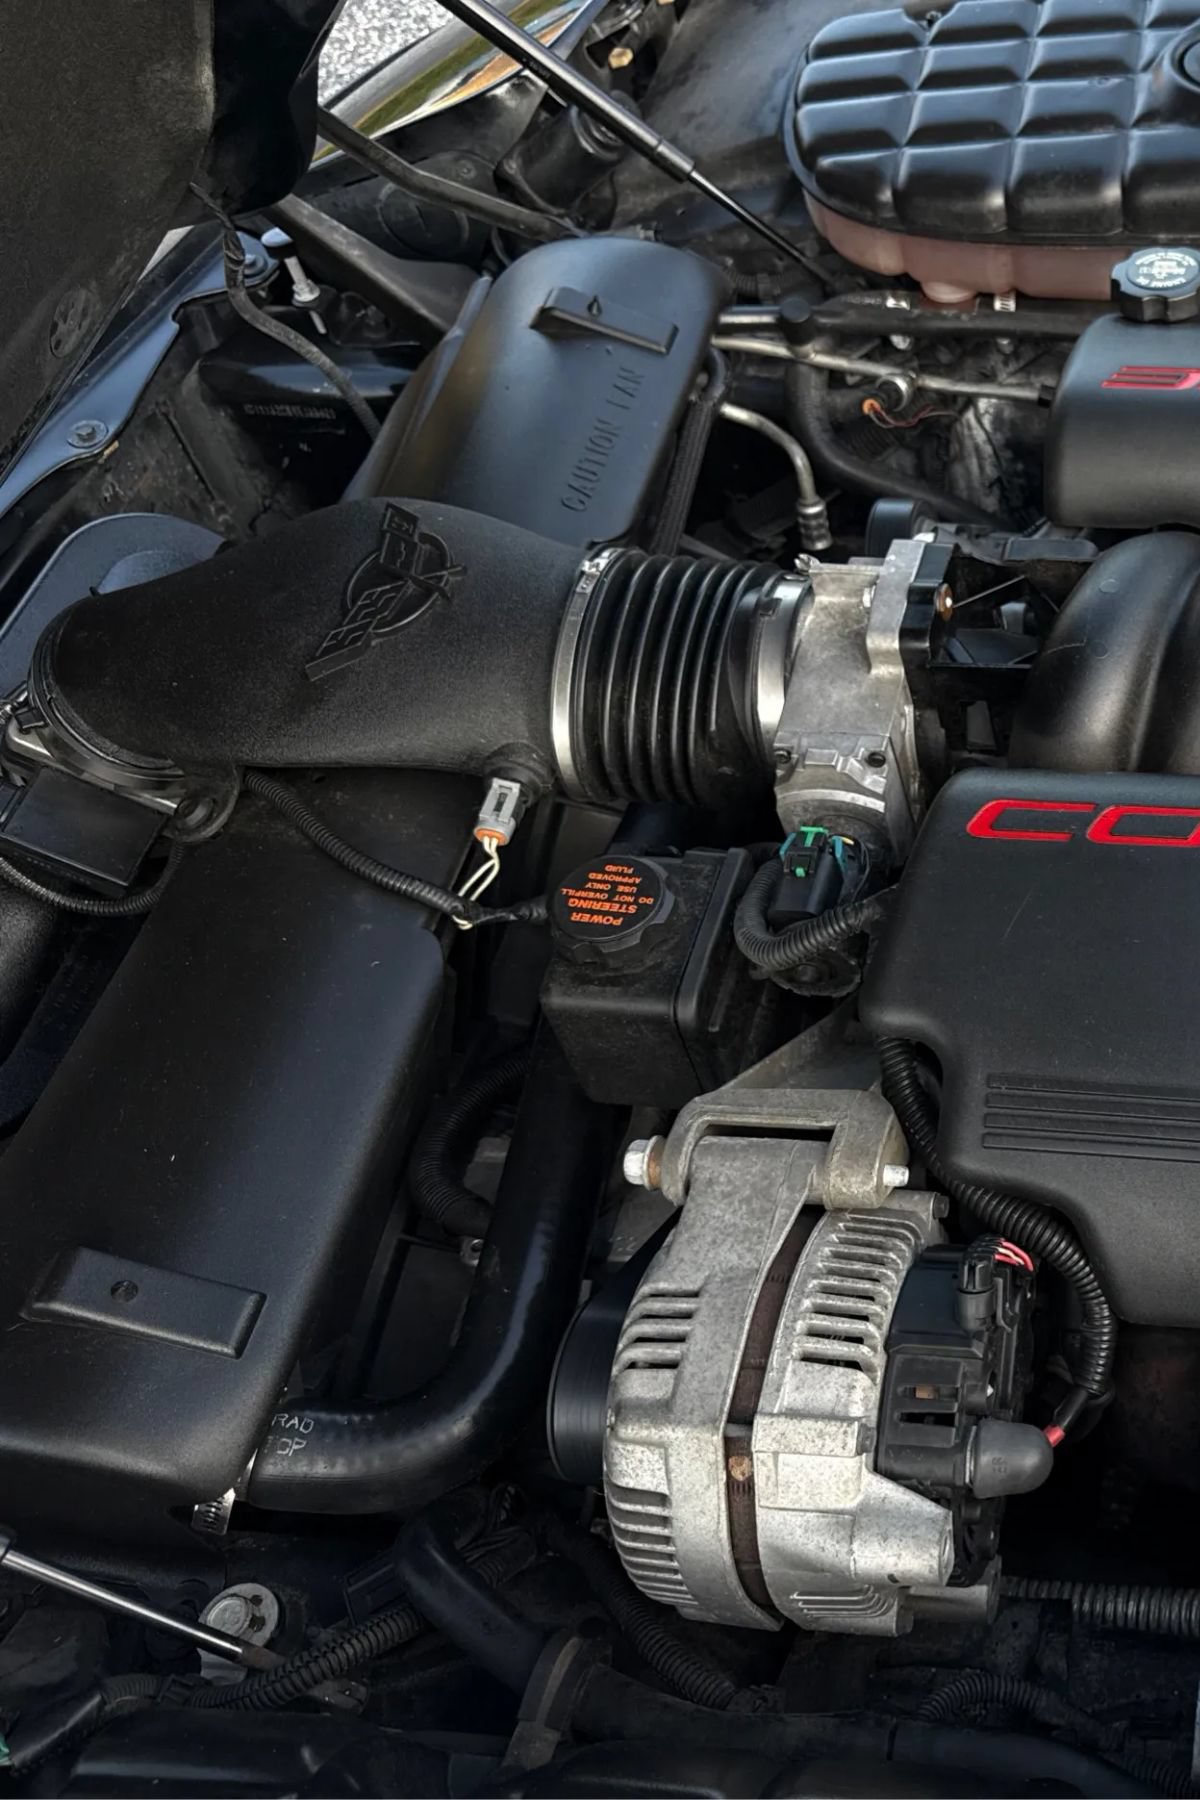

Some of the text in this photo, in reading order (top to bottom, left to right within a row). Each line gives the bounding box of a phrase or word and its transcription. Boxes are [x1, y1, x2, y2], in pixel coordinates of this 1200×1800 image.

[560, 417, 623, 513] CAUTION
[605, 864, 634, 874] FLUID
[588, 872, 642, 883] APPROVED
[585, 882, 638, 893] USE ONLY
[560, 888, 654, 905] DO NOT OVERFILL
[568, 898, 638, 914] STEERING
[570, 912, 624, 926] POWER
[271, 1413, 315, 1434] RAD
